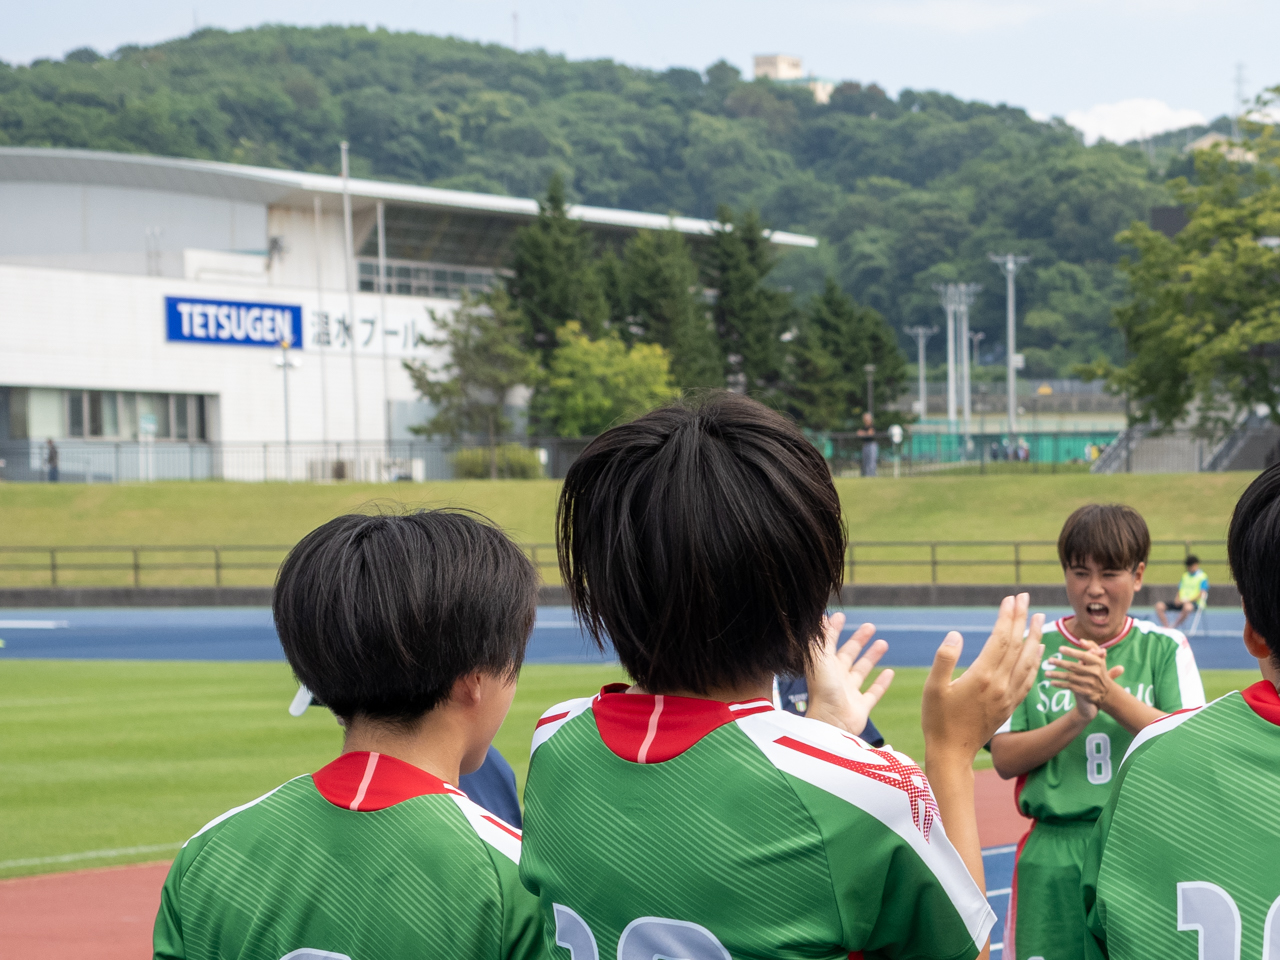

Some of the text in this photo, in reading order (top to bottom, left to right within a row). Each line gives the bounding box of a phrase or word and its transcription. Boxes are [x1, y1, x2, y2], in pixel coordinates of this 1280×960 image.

[177, 302, 293, 342] TETSUGEN
[311, 311, 420, 348] 温水プール
[1085, 732, 1112, 785] 8
